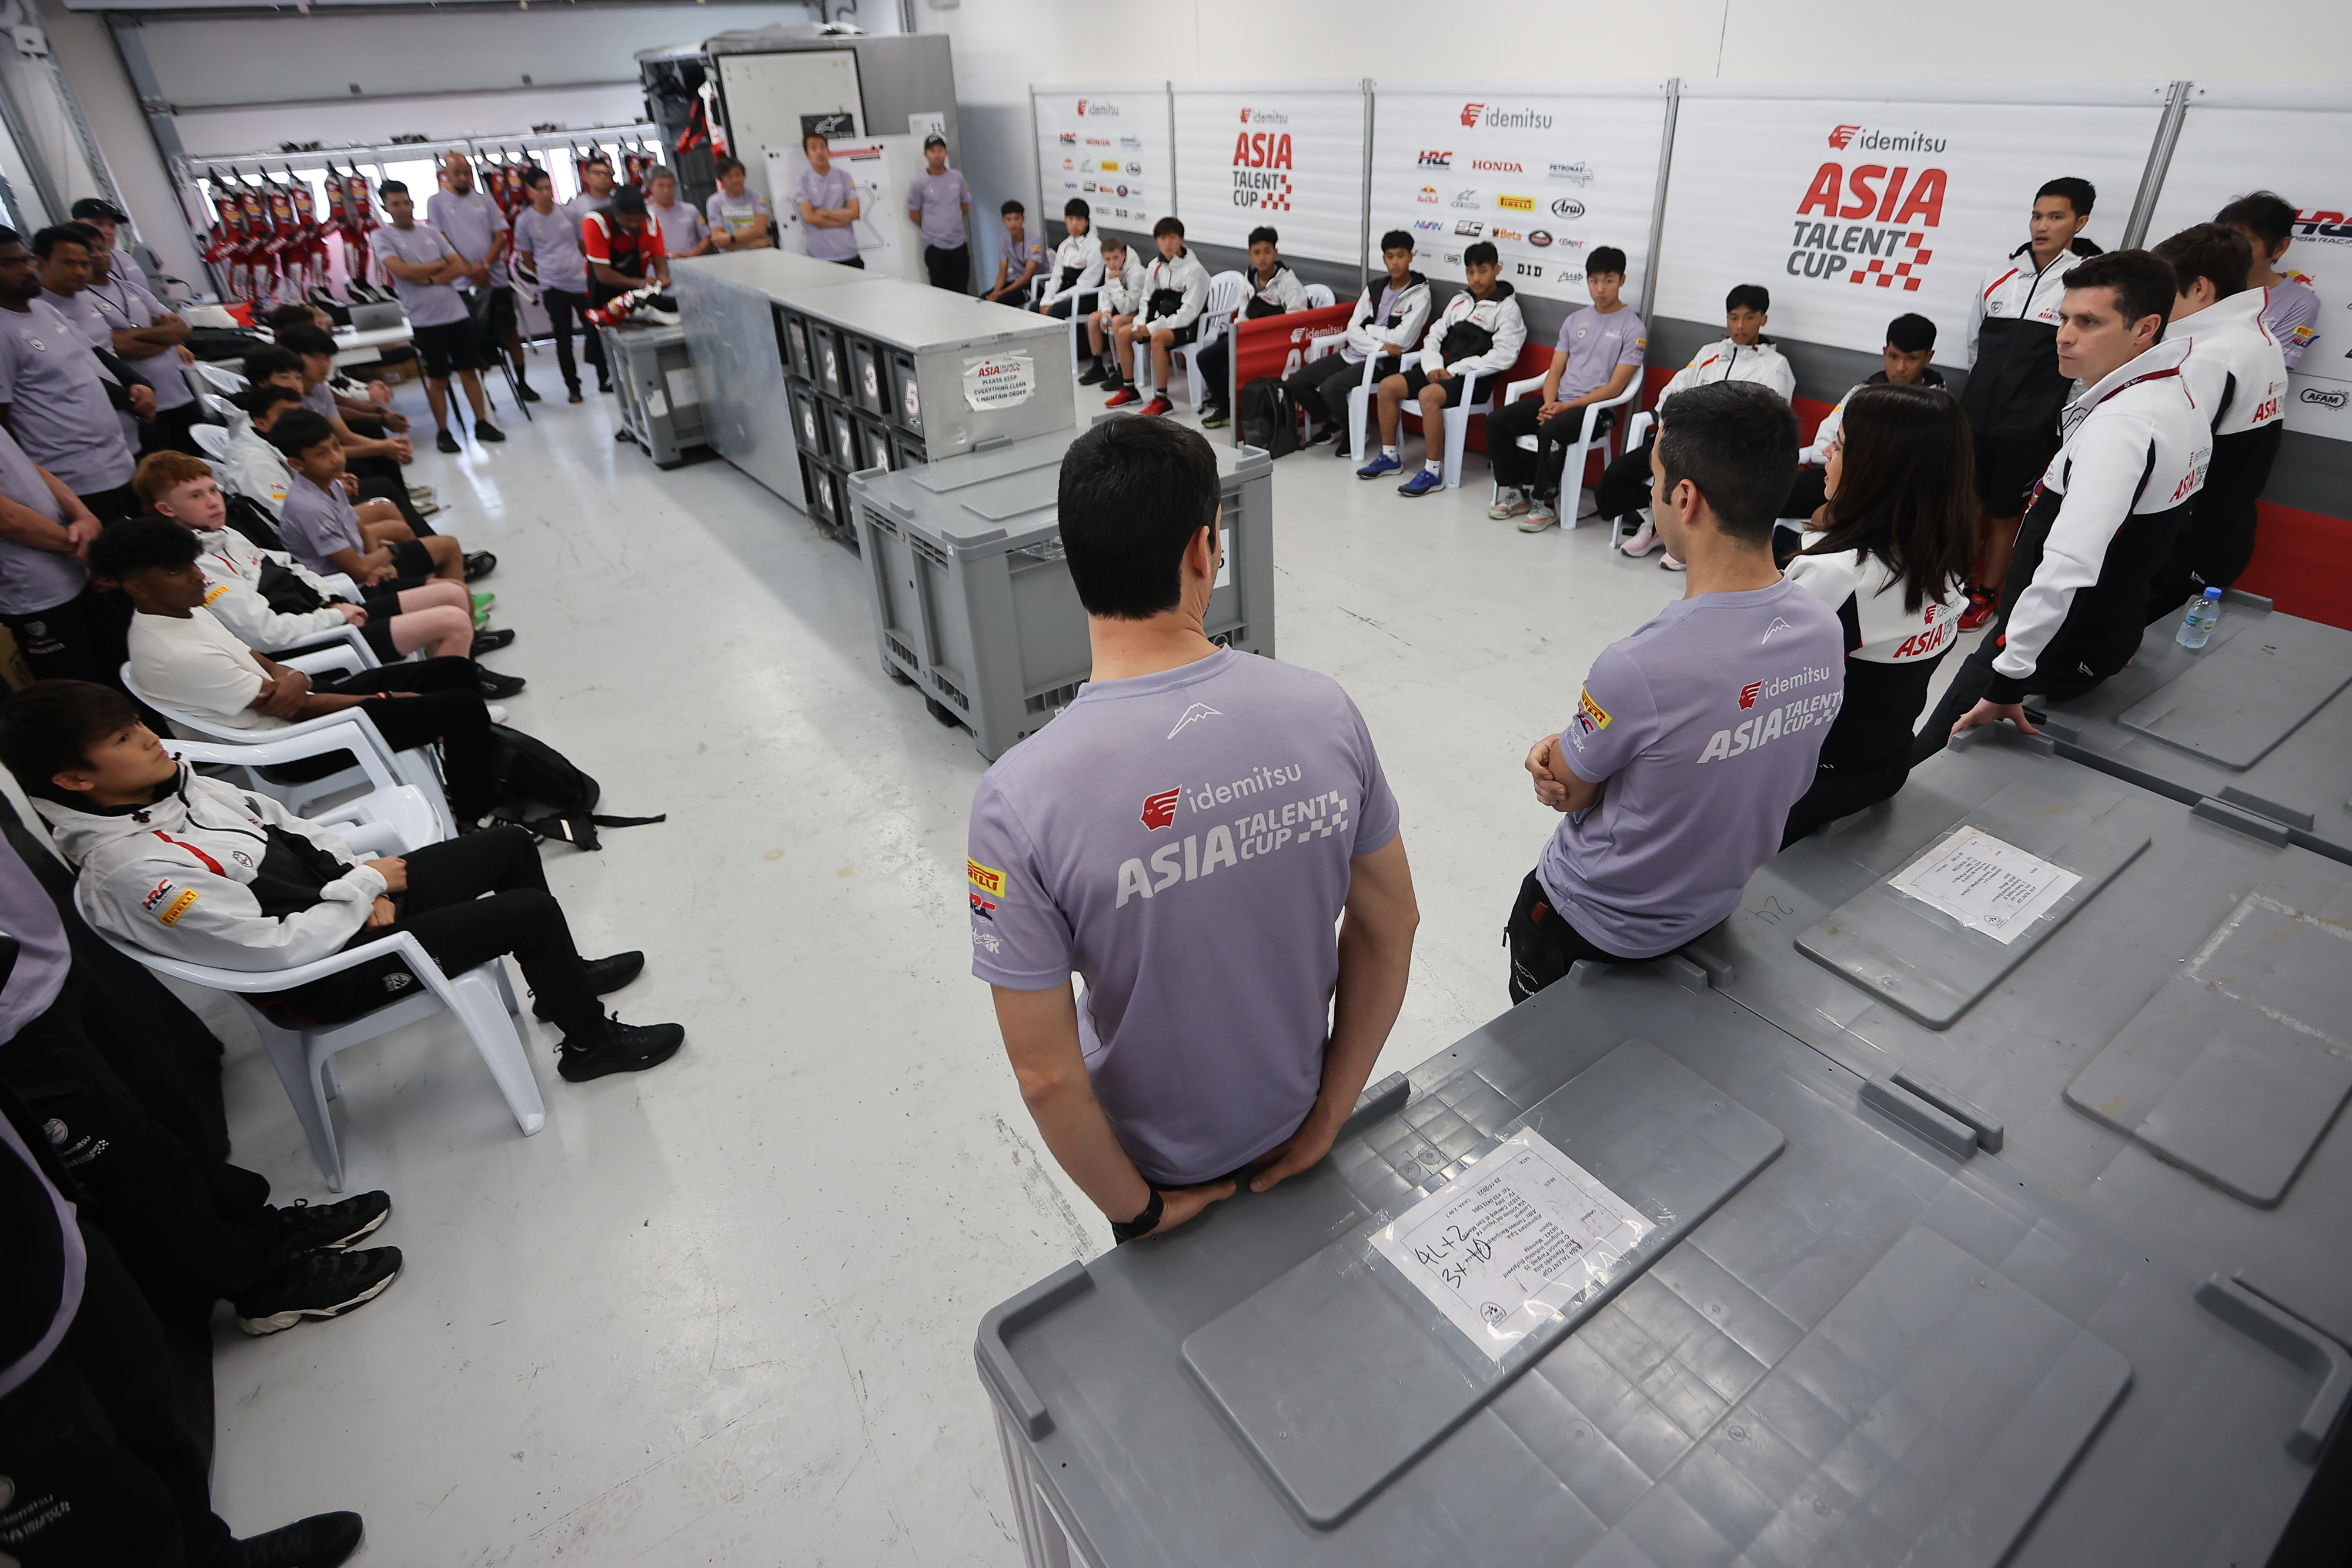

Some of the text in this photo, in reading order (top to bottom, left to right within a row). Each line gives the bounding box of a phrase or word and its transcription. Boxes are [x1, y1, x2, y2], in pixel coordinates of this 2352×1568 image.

[1252, 109, 1288, 124] idemitsu
[1485, 106, 1553, 129] idemitsu
[1859, 129, 1947, 153] idemitsu
[1232, 131, 1292, 170] ASIA
[1418, 150, 1452, 165] HRC
[1472, 159, 1524, 173] HONDA
[1232, 170, 1279, 190] TALENT
[1233, 189, 1258, 207] CUP
[1500, 196, 1532, 209] PIRELLI
[1796, 162, 1947, 228] ASIA
[1555, 200, 1581, 213] Arai
[1500, 229, 1522, 241] Beta
[1793, 221, 1906, 258] TALENT
[1786, 250, 1847, 280] CUP
[1305, 324, 1344, 340] idemitsu
[826, 349, 838, 383] 2
[978, 365, 1000, 377] ASIA
[864, 363, 878, 397] 3
[982, 376, 1003, 385] PLEASE
[904, 379, 920, 416] 5
[974, 384, 1008, 394] EVERYTHING
[980, 392, 1007, 402] MAINTAIN
[1008, 389, 1027, 397] ORDER
[2307, 393, 2339, 404] AFAM
[804, 412, 816, 439] 6
[840, 427, 851, 457] 7
[2168, 469, 2195, 503] ASIA
[818, 479, 834, 511] 10
[1893, 623, 1943, 658] ASIA
[1765, 667, 1829, 699] idemitsu
[1696, 691, 1839, 764] ASIA TALENT
[1783, 713, 1814, 735] CUP
[1186, 764, 1302, 813] idemitsu
[1115, 794, 1328, 908] ASIA TALENT
[1241, 828, 1292, 860] CUP
[968, 868, 998, 891] RELLI
[142, 878, 173, 911] HRC
[162, 891, 196, 924] PIRELLI
[970, 892, 997, 922] RC
[1518, 1156, 1530, 1165] DATA:
[1476, 1176, 1502, 1196] 29-11-2023
[1499, 1186, 1511, 1194] Tel:
[1456, 1198, 1471, 1209] CAIXA:
[1493, 1196, 1506, 1207] Italy
[1506, 1195, 1521, 1206] 31031
[1516, 1199, 1526, 1207] Via
[1489, 1203, 1508, 1219] Caerano
[1502, 1205, 1519, 1218] Vittime
[1512, 1203, 1532, 1219] Lunardi
[1524, 1208, 1538, 1219] Attn:
[1475, 1218, 1486, 1227] San
[1480, 1218, 1497, 1232] Vajont
[1507, 1216, 1526, 1231] Tomaso
[1516, 1212, 1543, 1233] Alpinestars
[1537, 1221, 1553, 1233] Spain
[1460, 1225, 1477, 1239] Marco
[1544, 1225, 1558, 1238] 08243
[1523, 1236, 1544, 1253] Manresa
[1547, 1238, 1565, 1252] Ramón
[1562, 1238, 1576, 1249] Attn:
[1523, 1244, 1545, 1262] Industrial
[1528, 1249, 1549, 1266] Farguell,
[1541, 1243, 1582, 1277] ASIA TALENT CUP
[1542, 1247, 1565, 1266] Francesc
[1501, 1258, 1526, 1279] Bufalvent
